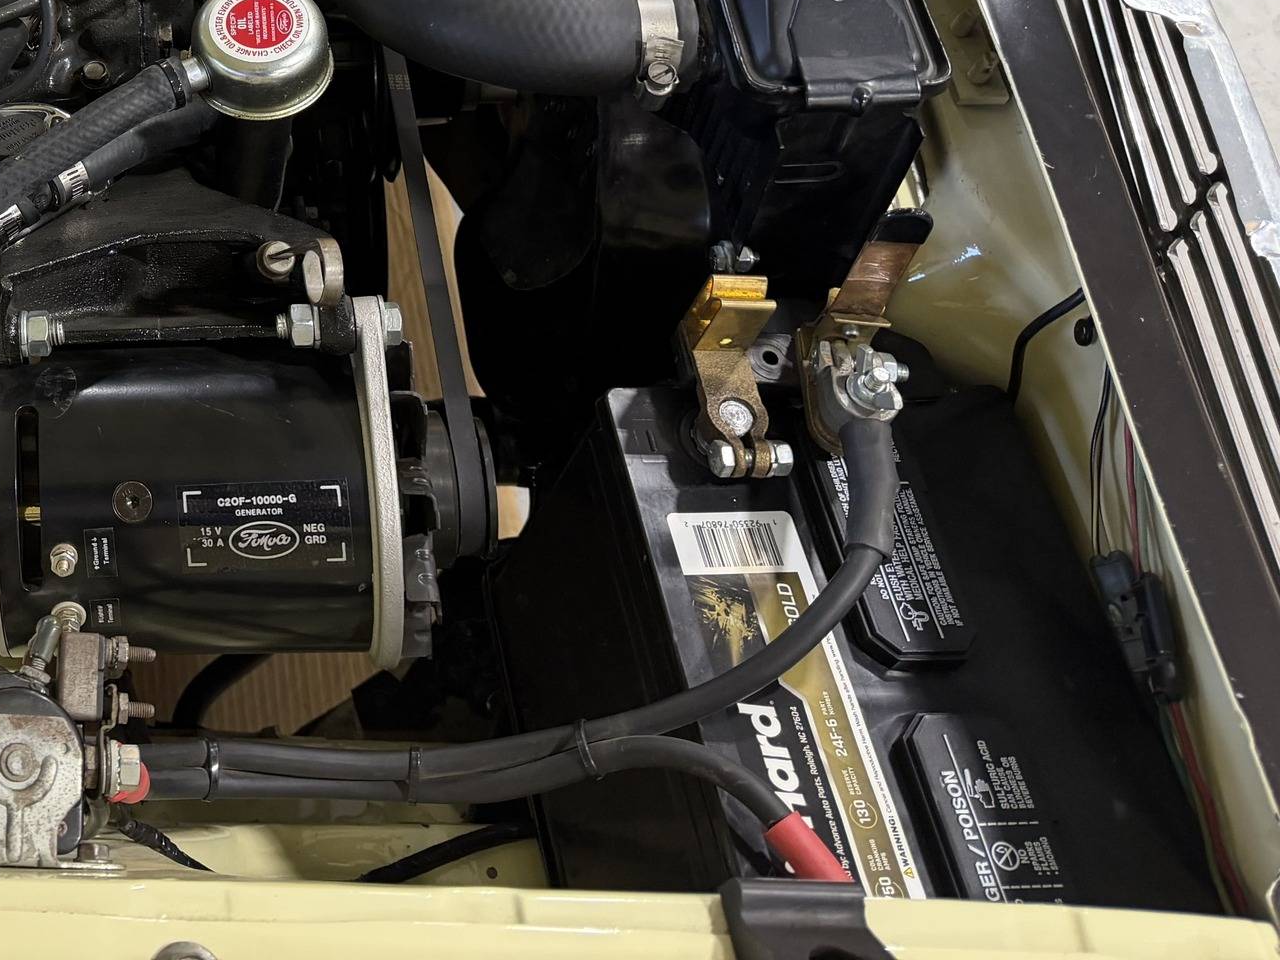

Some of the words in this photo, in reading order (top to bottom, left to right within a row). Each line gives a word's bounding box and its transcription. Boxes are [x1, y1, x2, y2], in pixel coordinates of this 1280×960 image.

[221, 0, 235, 17] EVERY
[294, 7, 305, 29] WHEN
[215, 17, 224, 37] FILTER
[237, 17, 247, 30] OIL
[247, 12, 255, 35] LABELED
[292, 28, 304, 40] OIL
[224, 39, 236, 50] OIL
[235, 48, 269, 57] CHANGE
[273, 36, 297, 54] CHECK
[827, 461, 843, 492] CHILDREN
[838, 492, 847, 502] OF
[235, 508, 284, 517] GENERATOR
[200, 527, 213, 536] 15
[214, 527, 222, 536] V
[303, 523, 326, 533] NEG
[900, 514, 917, 545] STARTING
[201, 539, 213, 548] 30
[217, 539, 225, 548] A
[305, 535, 327, 545] GRD
[920, 527, 935, 553] SERVICE
[92, 543, 100, 566] Ground
[101, 538, 110, 565] Terminal
[896, 542, 910, 564] HELP
[912, 546, 922, 562] JUMP
[918, 544, 933, 570] VEHICLE
[929, 553, 941, 570] SEEK
[905, 566, 925, 601] MEDICAL
[919, 564, 930, 581] SAFE
[928, 571, 937, 579] IN
[880, 589, 890, 600] DO
[889, 574, 906, 601] FLUSH
[900, 579, 914, 601] WITH
[925, 581, 935, 596] FOR
[936, 571, 955, 605] AVAILABLE
[931, 579, 955, 626] INSTRUCTIONS
[949, 604, 961, 620] NOT
[819, 701, 829, 716] PART
[823, 691, 835, 716] NUMBER
[790, 706, 803, 730] 27604
[798, 730, 809, 744] NC
[825, 718, 848, 758] 24F-6
[977, 740, 993, 762] ACID
[1001, 757, 1010, 768] OR
[1009, 756, 1025, 781] BURNS
[842, 769, 855, 796] RESERVE
[848, 767, 862, 796] CAPACITY
[986, 763, 1010, 810] SULFURIC
[996, 767, 1011, 793] CAUSE
[1006, 771, 1027, 809] BLINDNESS
[941, 770, 980, 841] POISON
[1003, 794, 1018, 810] CAN
[1019, 782, 1035, 809] SEVERE
[822, 800, 834, 820] Auto
[853, 800, 872, 825] 130
[829, 820, 846, 856] Advance
[888, 815, 910, 867] WARNING:
[867, 855, 877, 872] COLD
[869, 839, 884, 871] CRANKING
[881, 852, 892, 871] AMPS
[1018, 849, 1031, 864] NO
[1025, 841, 1042, 871] SPARKS
[1033, 842, 1050, 871] FLAMES
[1040, 837, 1059, 871] SMOKING
[879, 877, 895, 898] 50
[975, 861, 1001, 902] GER
